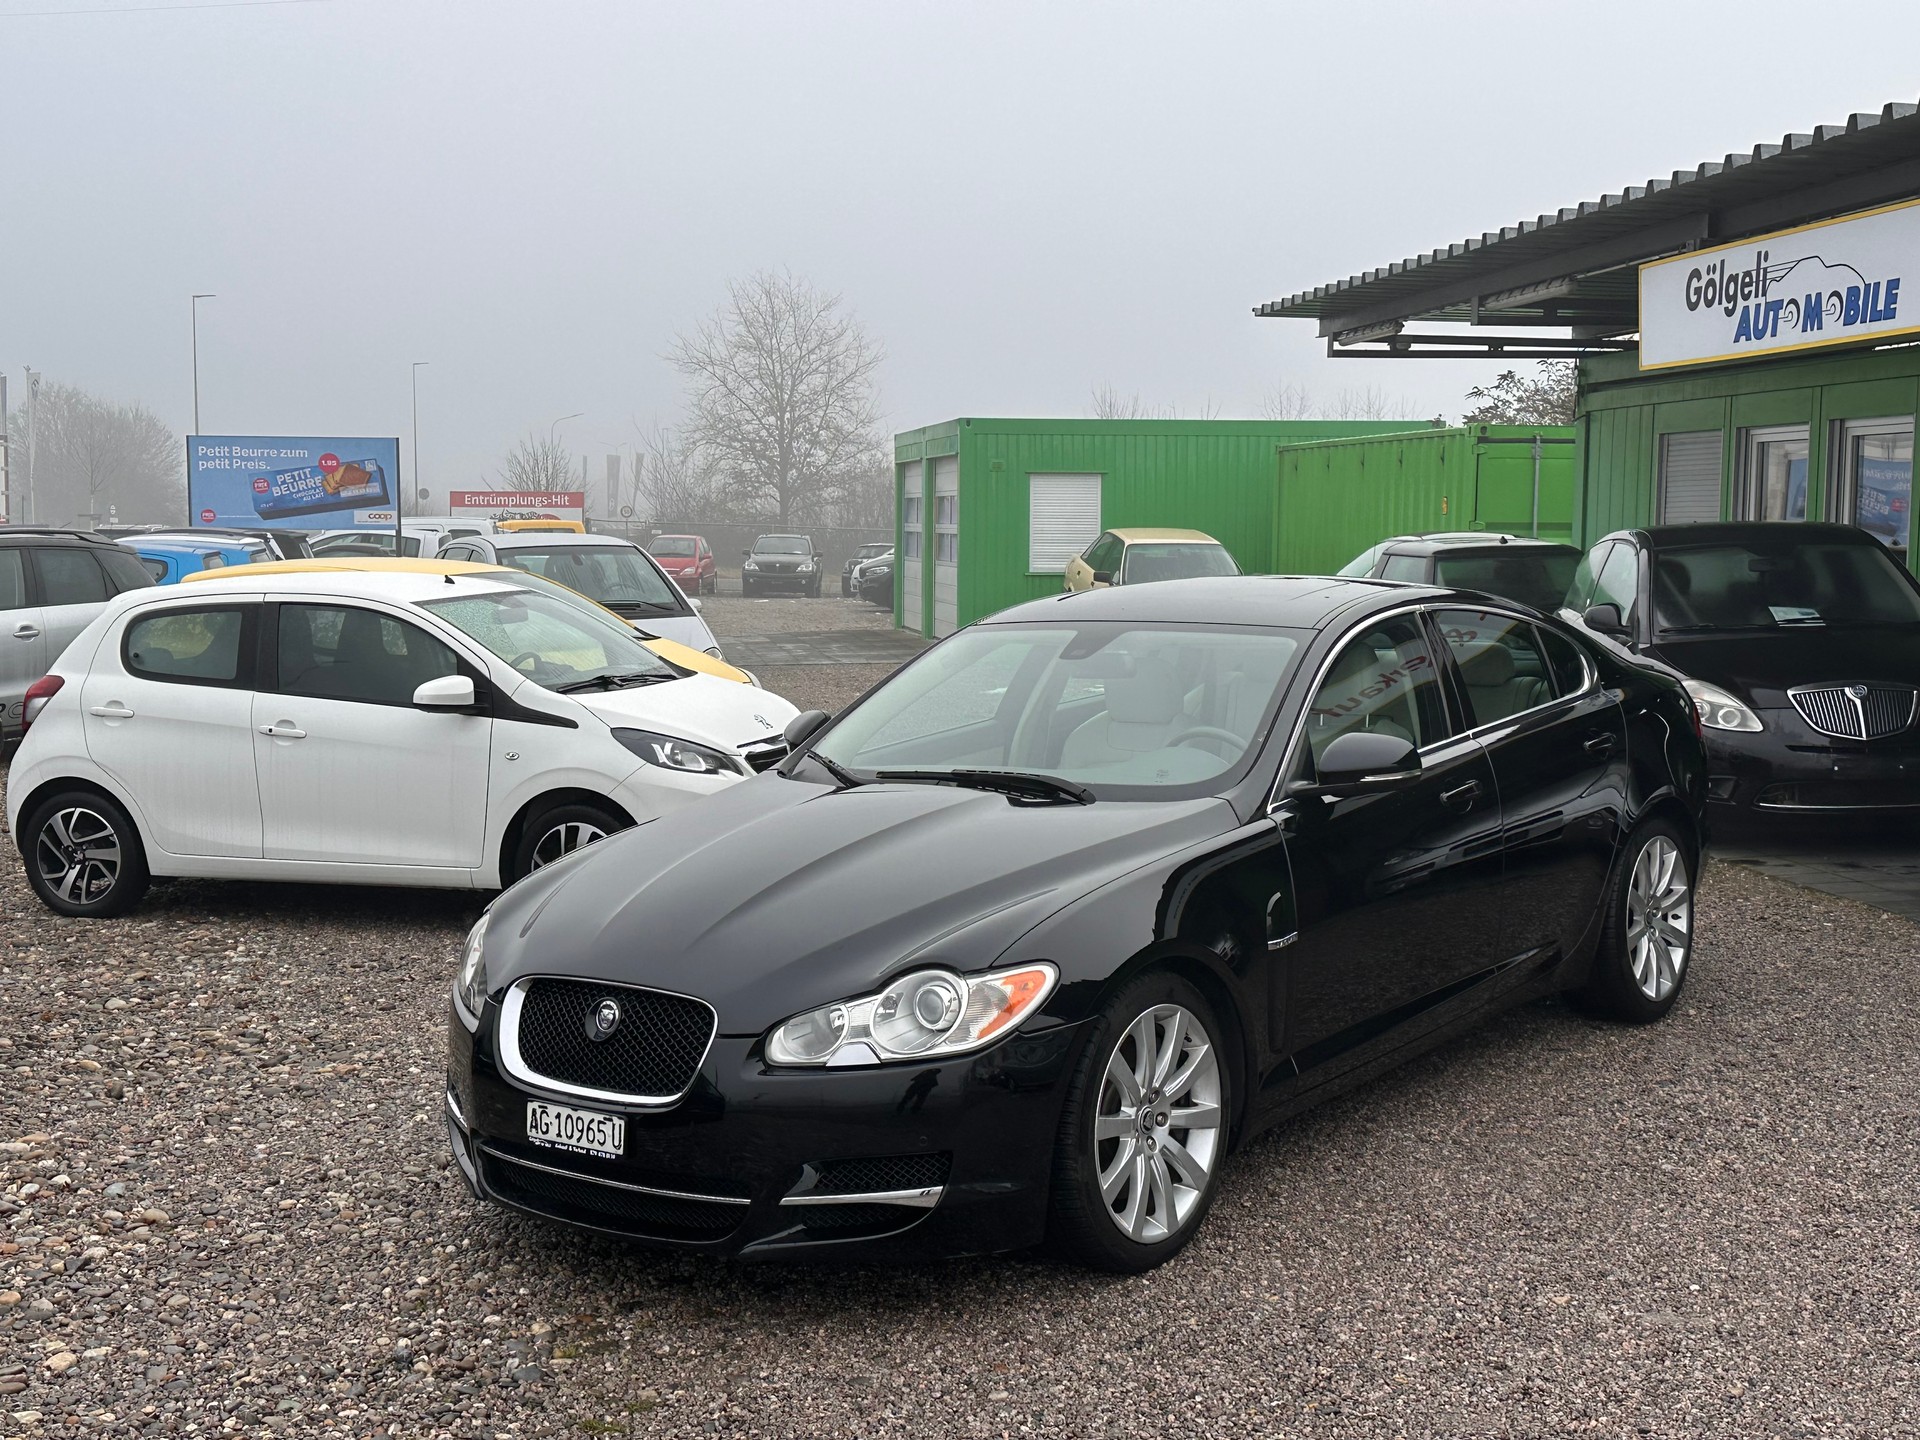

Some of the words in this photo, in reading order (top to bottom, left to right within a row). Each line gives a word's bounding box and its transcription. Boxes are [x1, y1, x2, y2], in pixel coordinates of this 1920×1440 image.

[1685, 250, 1769, 317] Gölgeli
[198, 446, 230, 457] Petit
[232, 446, 278, 457] Beurre
[280, 449, 308, 458] zum
[198, 459, 230, 471] petit
[233, 459, 271, 470] Preis.
[276, 468, 311, 485] PETIT
[272, 476, 322, 497] BEURRE
[292, 487, 323, 499] CHOCOLAT
[464, 494, 569, 507] Entrümplungs-Hit
[368, 513, 393, 521] coop
